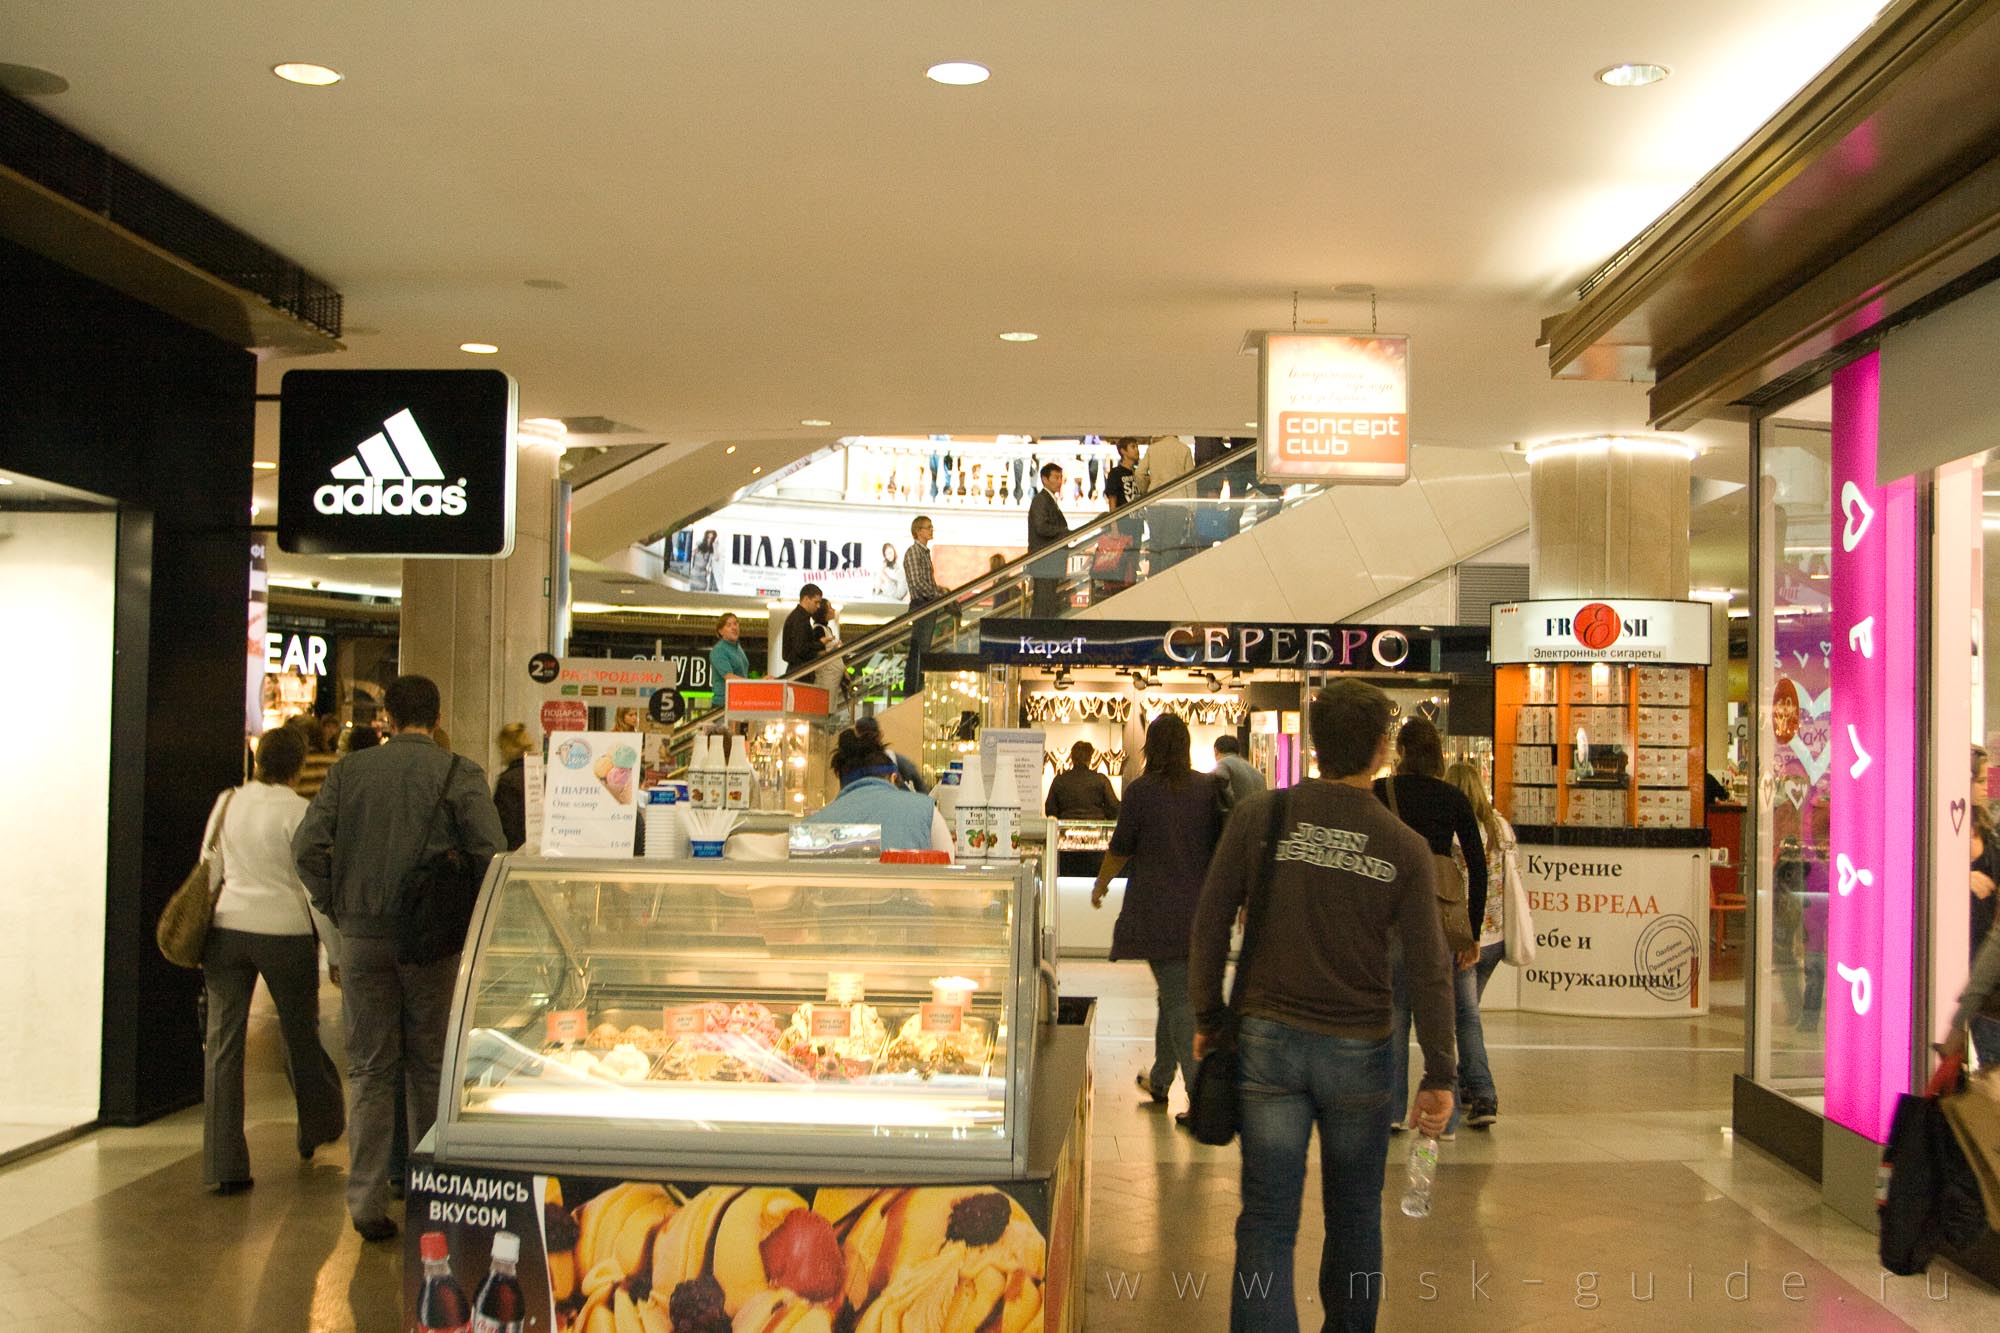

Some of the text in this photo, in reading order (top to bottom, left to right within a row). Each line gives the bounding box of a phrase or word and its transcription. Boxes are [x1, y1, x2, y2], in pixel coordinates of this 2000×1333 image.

[1286, 415, 1401, 439] concept
[1286, 436, 1349, 455] club
[313, 476, 468, 516] adidas
[731, 533, 863, 571] ПЛАТЬЯ
[1163, 626, 1410, 668] СЕРЕБРО
[1533, 648, 1662, 659] Электронные сигареты
[560, 668, 664, 684] РАСПРОДАЖА
[1289, 822, 1369, 853] JOHN
[1275, 840, 1397, 883] ICHMOND
[1527, 854, 1623, 881] Курение
[1527, 890, 1661, 919] БЕЗ ВРЕДА
[1535, 928, 1592, 950] ебе и
[1526, 967, 1682, 991] окружающим!
[411, 1169, 530, 1203] НАСЛАДИСЬ
[429, 1200, 507, 1228] ВКУСОМ
